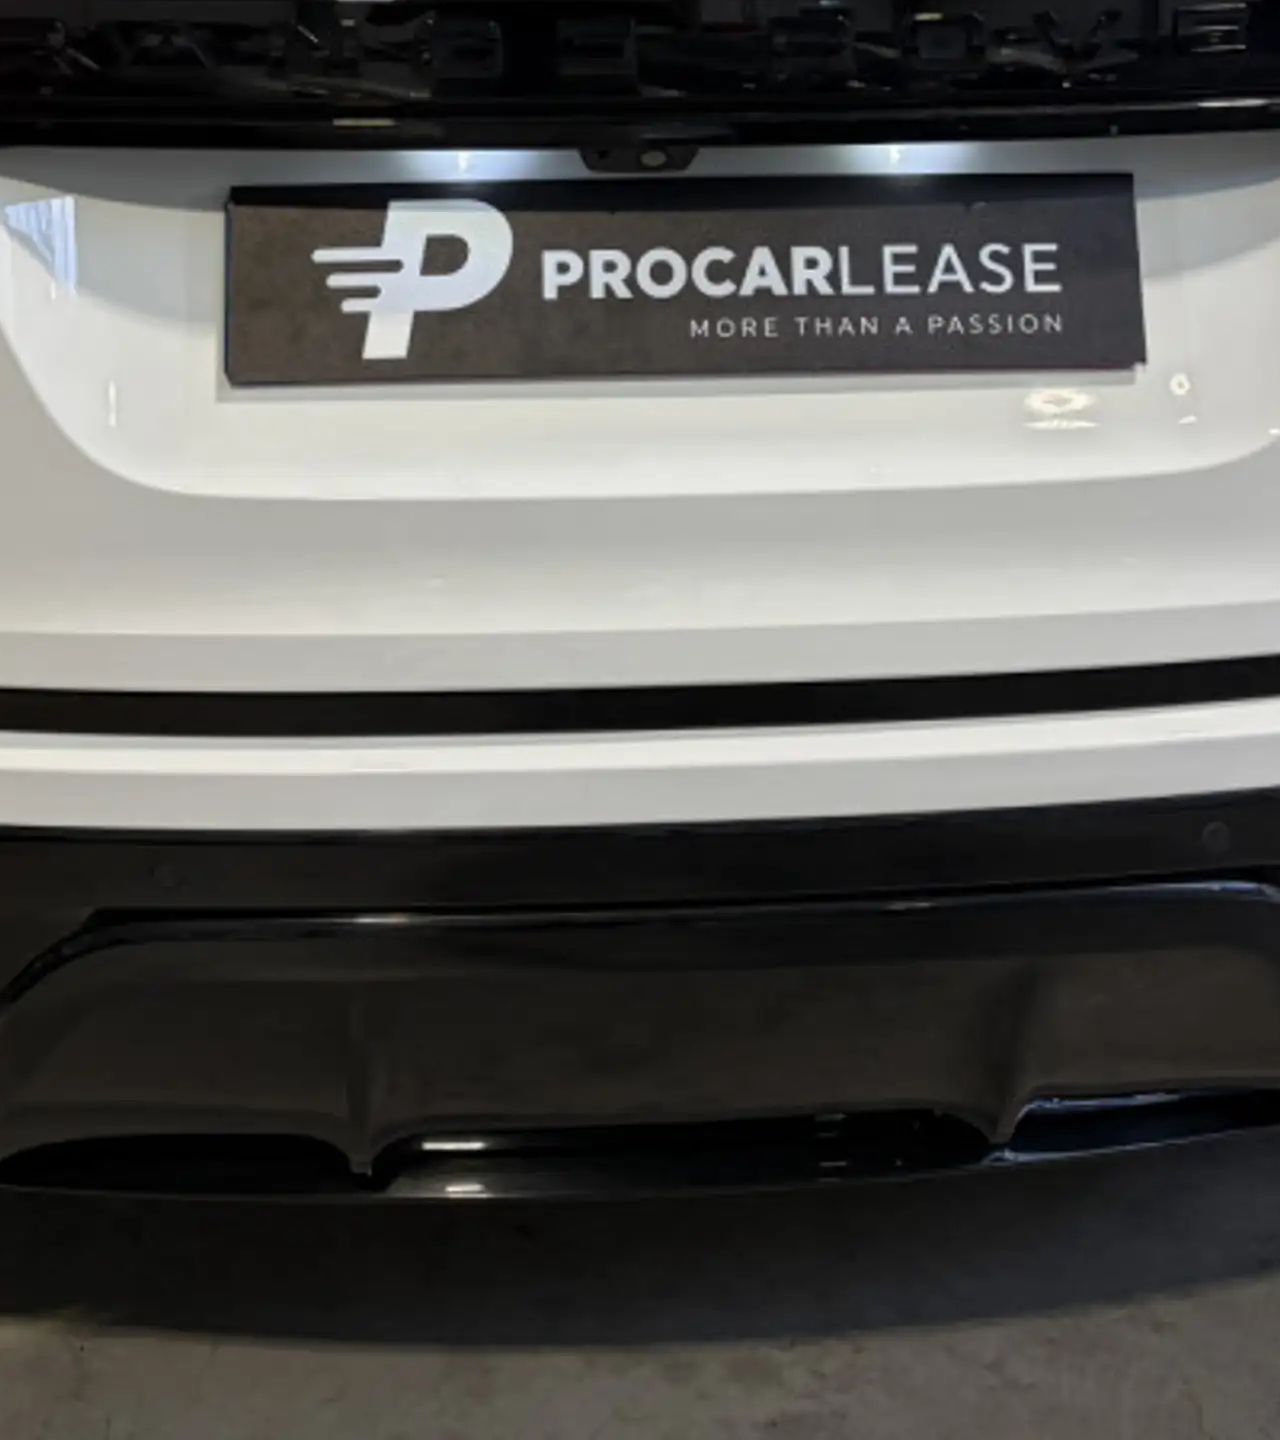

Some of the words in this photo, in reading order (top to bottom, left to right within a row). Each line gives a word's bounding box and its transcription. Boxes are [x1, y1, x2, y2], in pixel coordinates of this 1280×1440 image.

[542, 243, 1062, 300] PROCARLEASE
[690, 316, 779, 338] MORE
[794, 315, 879, 336] THAN
[895, 316, 913, 335] A
[927, 313, 1062, 335] PASSION
